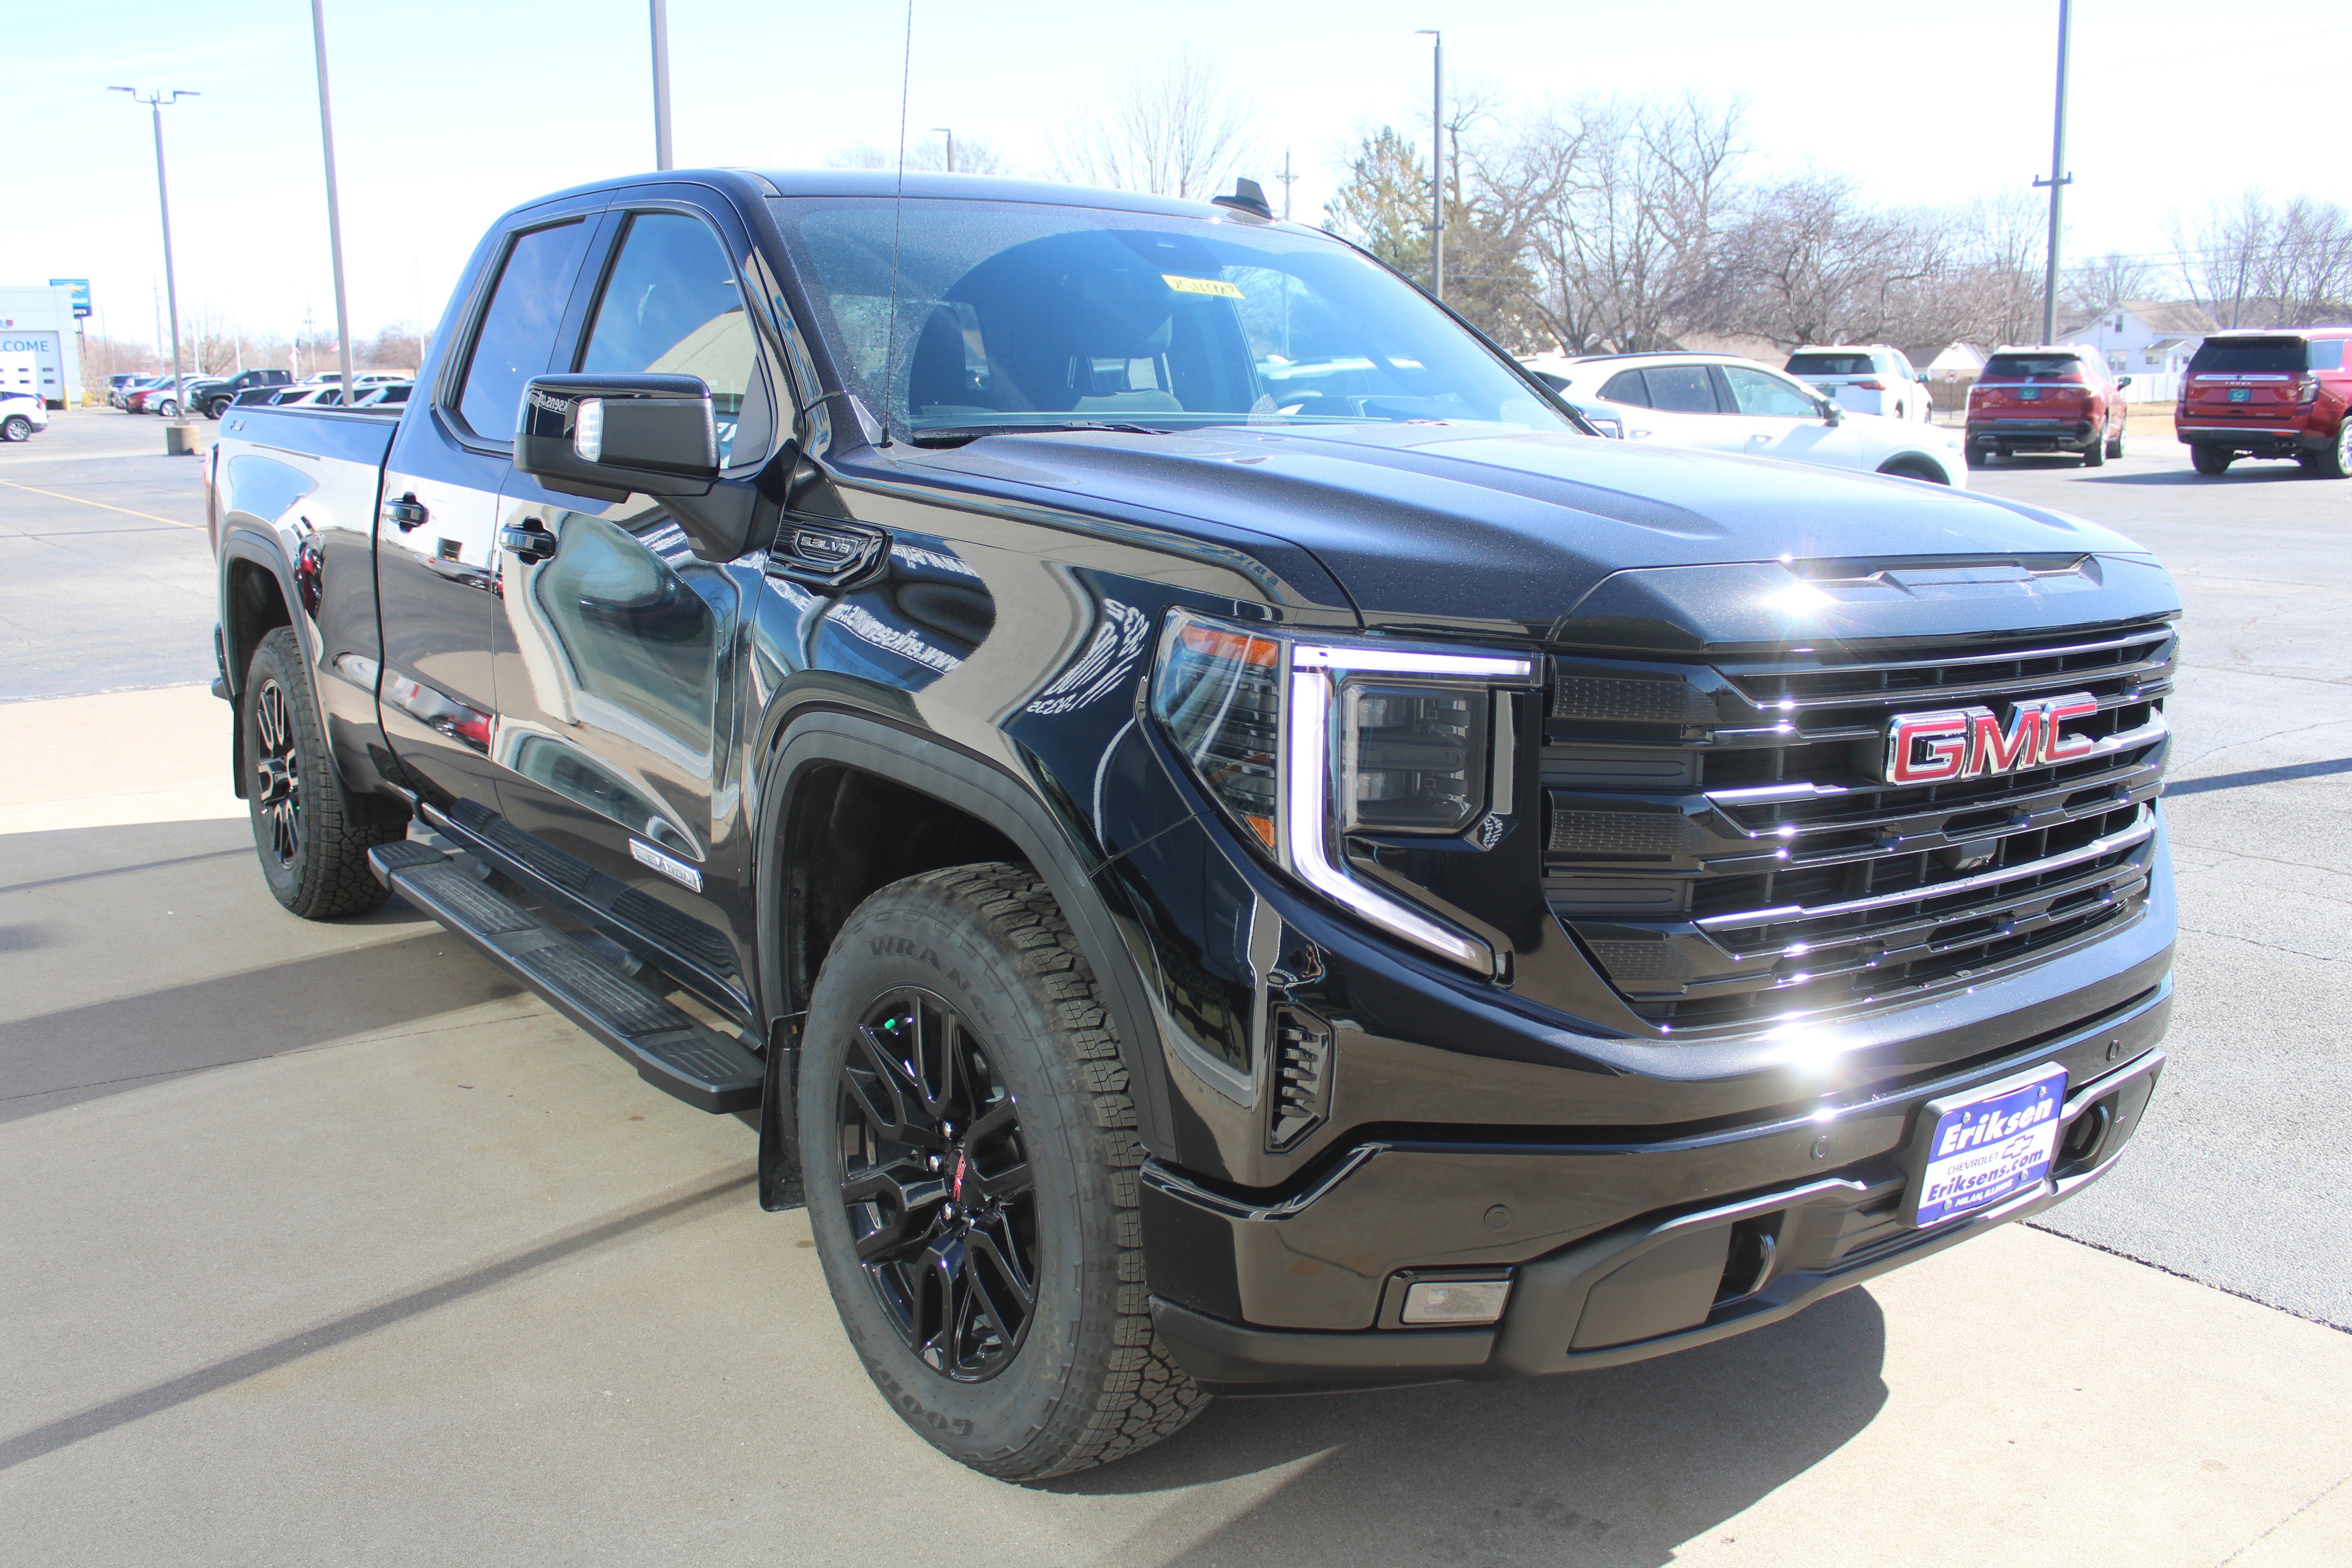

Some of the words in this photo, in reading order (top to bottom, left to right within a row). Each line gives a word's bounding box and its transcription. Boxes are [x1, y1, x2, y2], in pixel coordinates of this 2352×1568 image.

[0, 341, 49, 352] COME
[800, 536, 830, 550] 5.3L
[832, 541, 850, 554] V8
[1886, 691, 2097, 786] GMC
[635, 848, 694, 884] ELEVATION
[1938, 1098, 2053, 1156] Eriksen
[953, 1156, 967, 1201] GMC
[1927, 1149, 2043, 1202] Eriksens.com
[1947, 1152, 2000, 1175] CHEVROLET
[1954, 1192, 1983, 1207] MILAN,
[1983, 1178, 2014, 1198] ILLINOIS
